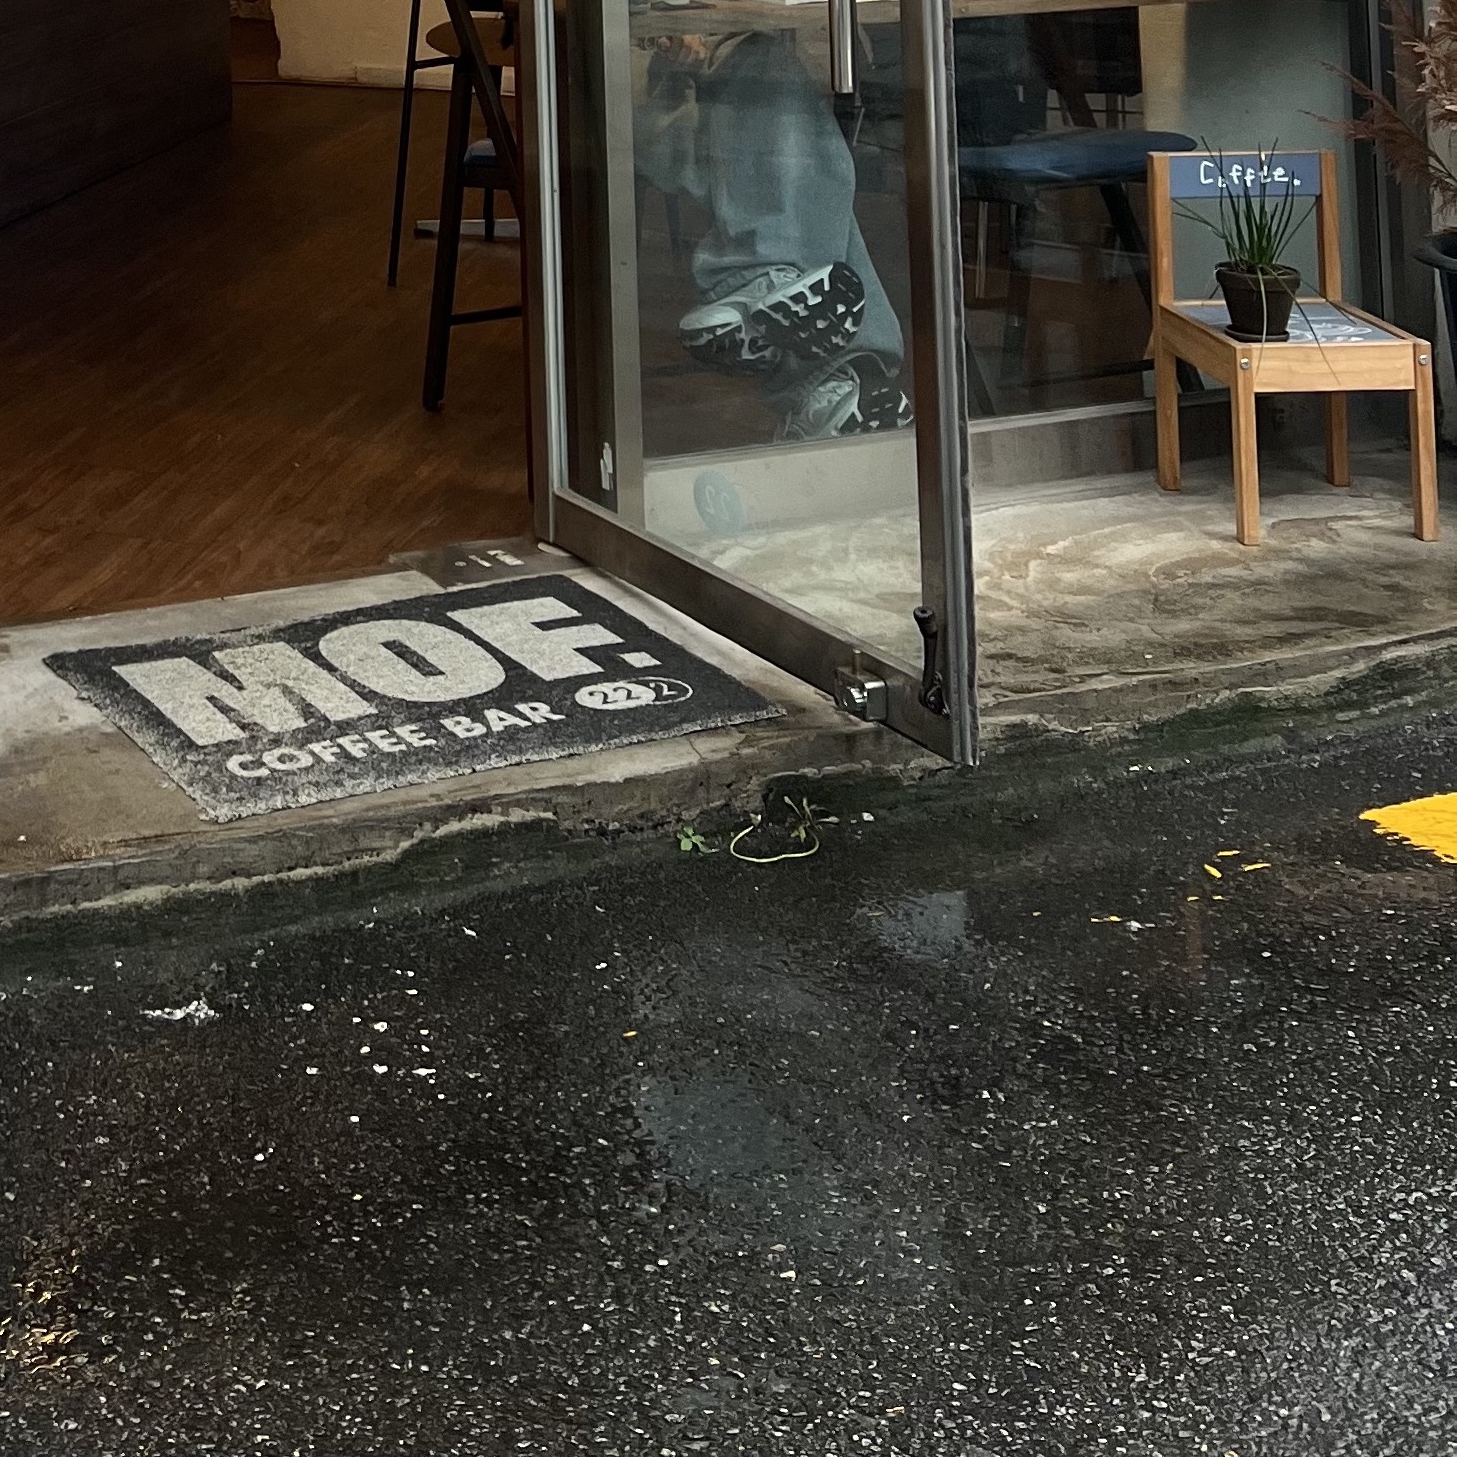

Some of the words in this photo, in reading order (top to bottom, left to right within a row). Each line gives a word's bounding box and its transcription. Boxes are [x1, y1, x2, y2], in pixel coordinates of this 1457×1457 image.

[111, 596, 662, 747] MOF.
[226, 723, 437, 777] COFFEE
[440, 701, 566, 740] BAR
